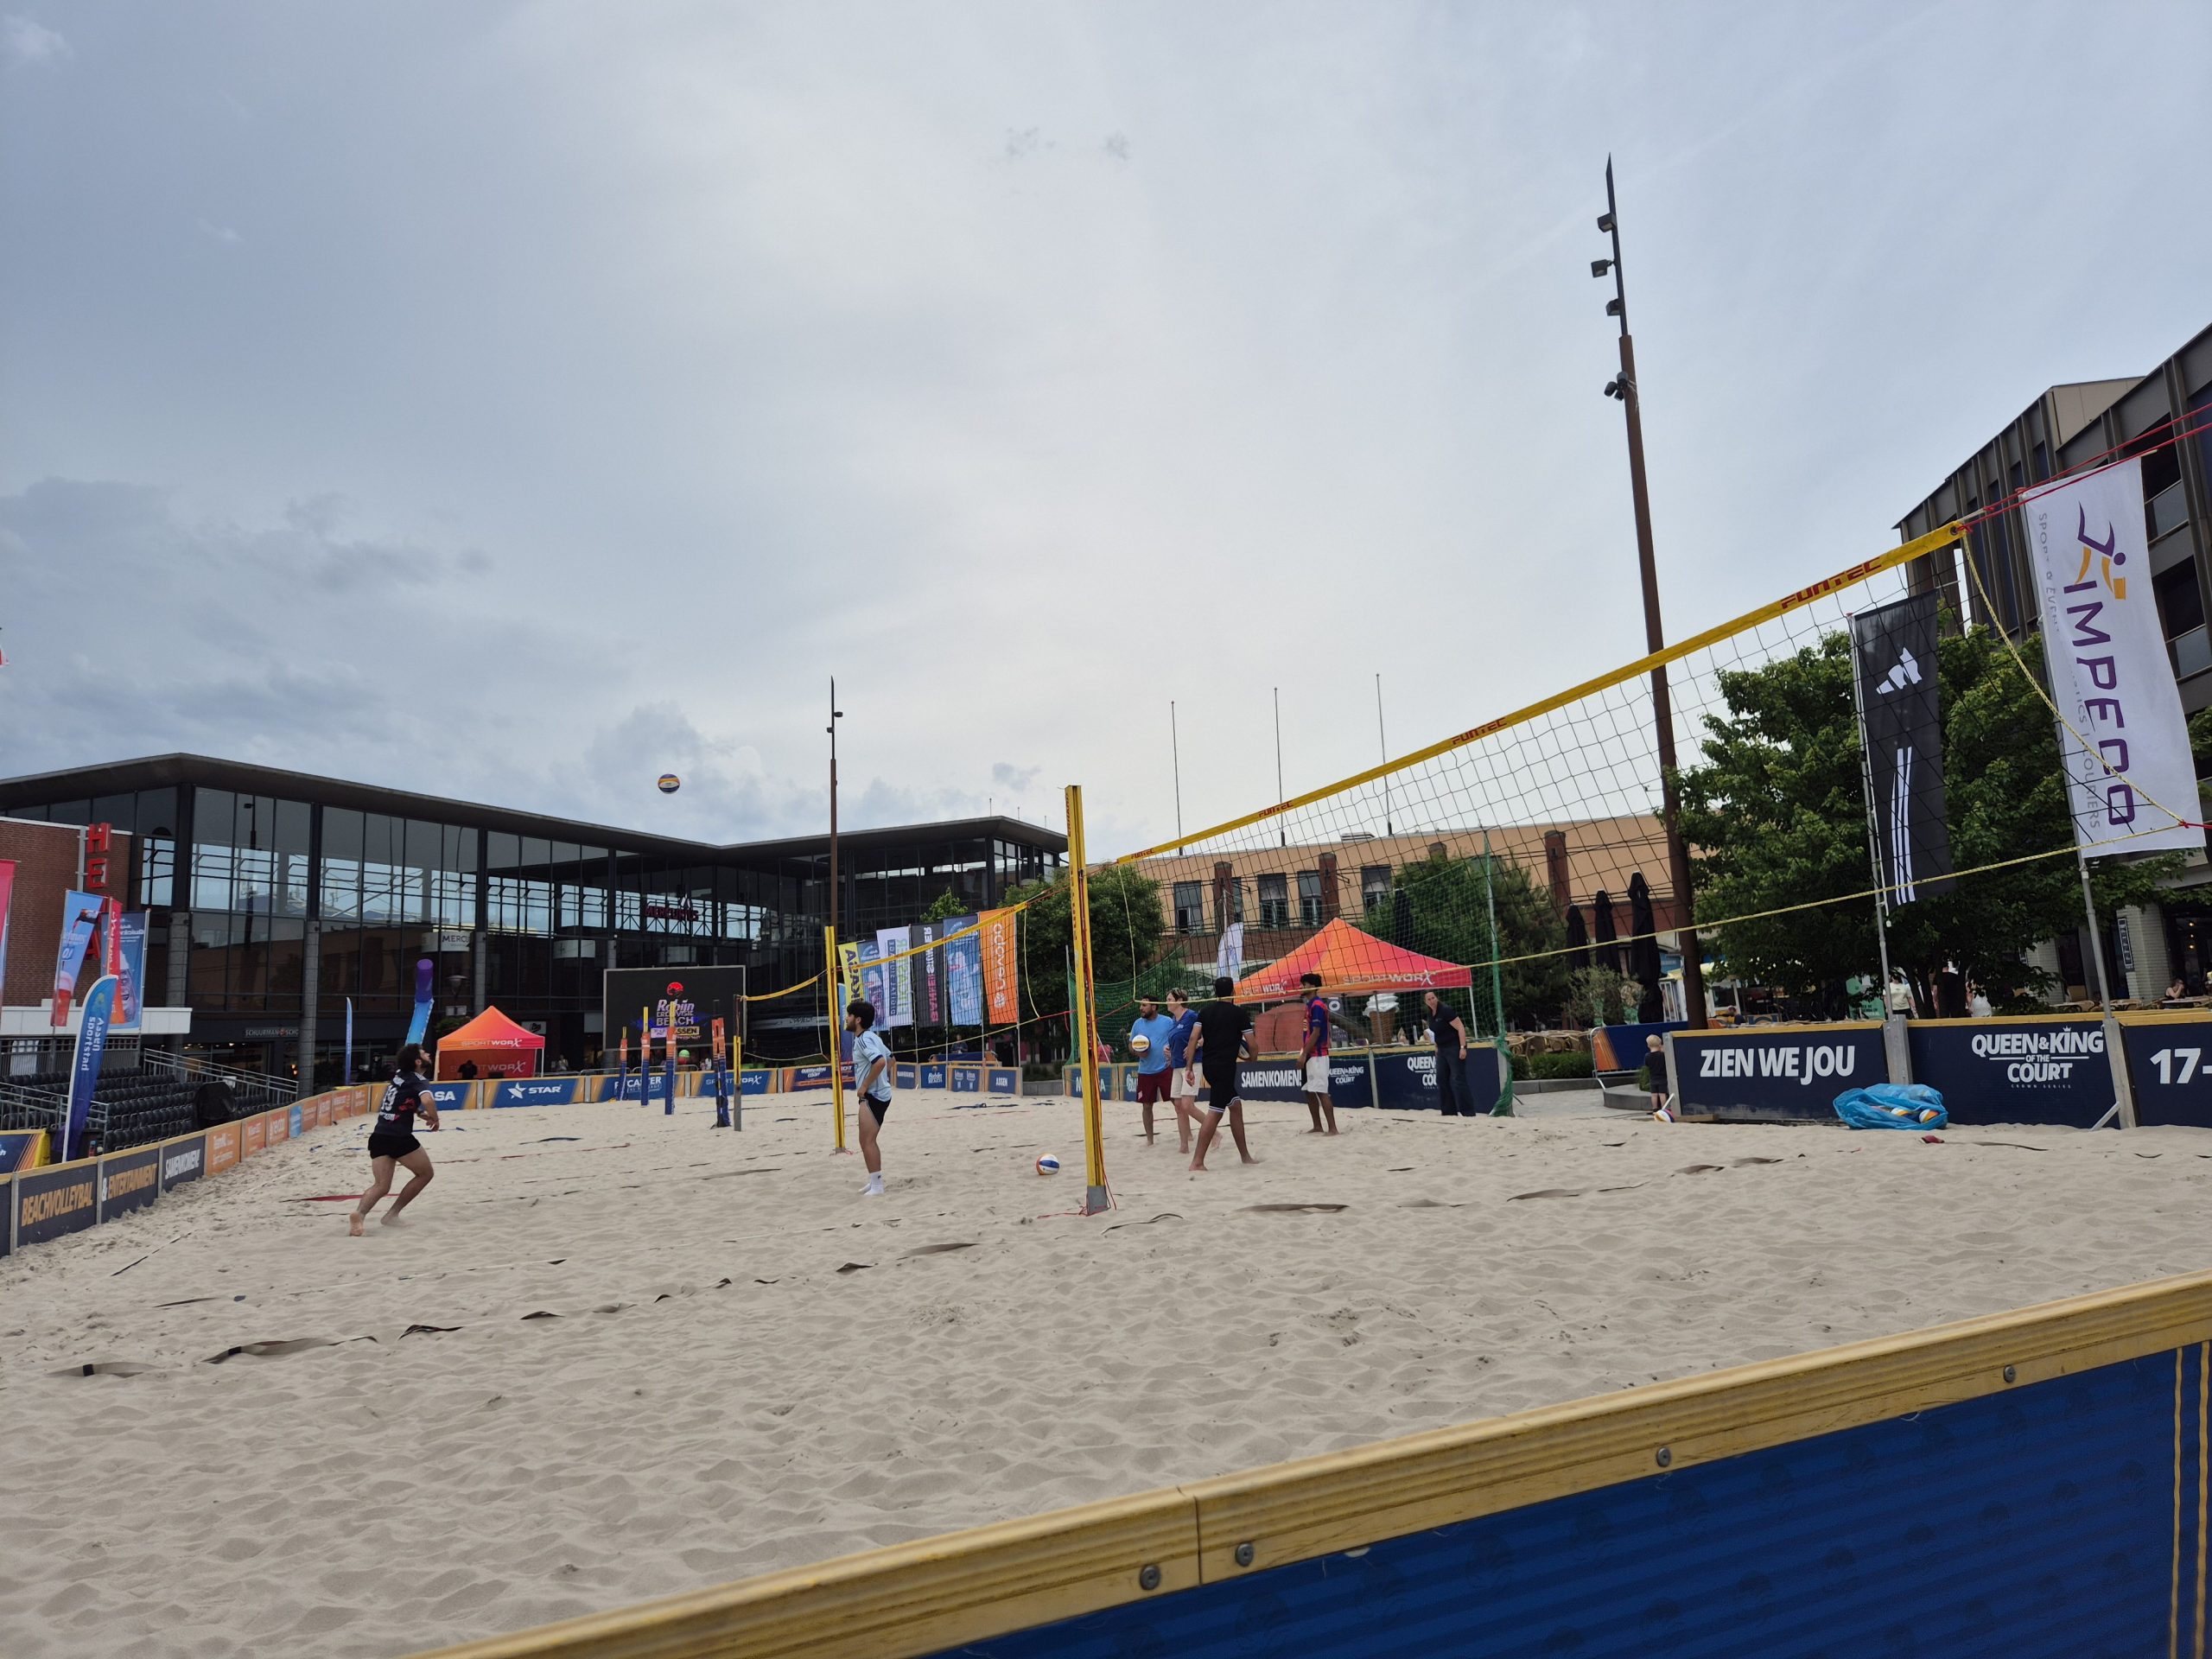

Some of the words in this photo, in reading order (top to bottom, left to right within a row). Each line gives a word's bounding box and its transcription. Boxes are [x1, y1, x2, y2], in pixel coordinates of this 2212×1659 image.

[1780, 556, 1882, 609] FUNTEC
[2063, 580, 2136, 826] IMPECO
[1452, 716, 1507, 745] FUNTEC
[1259, 800, 1294, 818] FUNTEC
[87, 823, 112, 961] HEA
[80, 1016, 96, 1071] sportstad
[92, 1017, 105, 1052] Assen
[461, 1038, 523, 1048] SPORTWORX
[1971, 1026, 2104, 1058] QUEEN&KING
[449, 1059, 527, 1073] STWORX
[1700, 1048, 1754, 1077] ZIEN
[1758, 1046, 1800, 1077] WE
[1800, 1045, 1855, 1085] JOU
[2007, 1062, 2073, 1083] COURT
[2025, 1054, 2035, 1063] OF
[2036, 1054, 2050, 1063] THE
[528, 1085, 560, 1094] STAR
[1241, 1069, 1302, 1089] SAMENKOMEN!
[1335, 1076, 1356, 1084] COURT
[102, 1177, 108, 1202] &
[108, 1163, 157, 1199] ENTERTAINMENT
[21, 1181, 93, 1228] BEACHVOLLEYBAL
